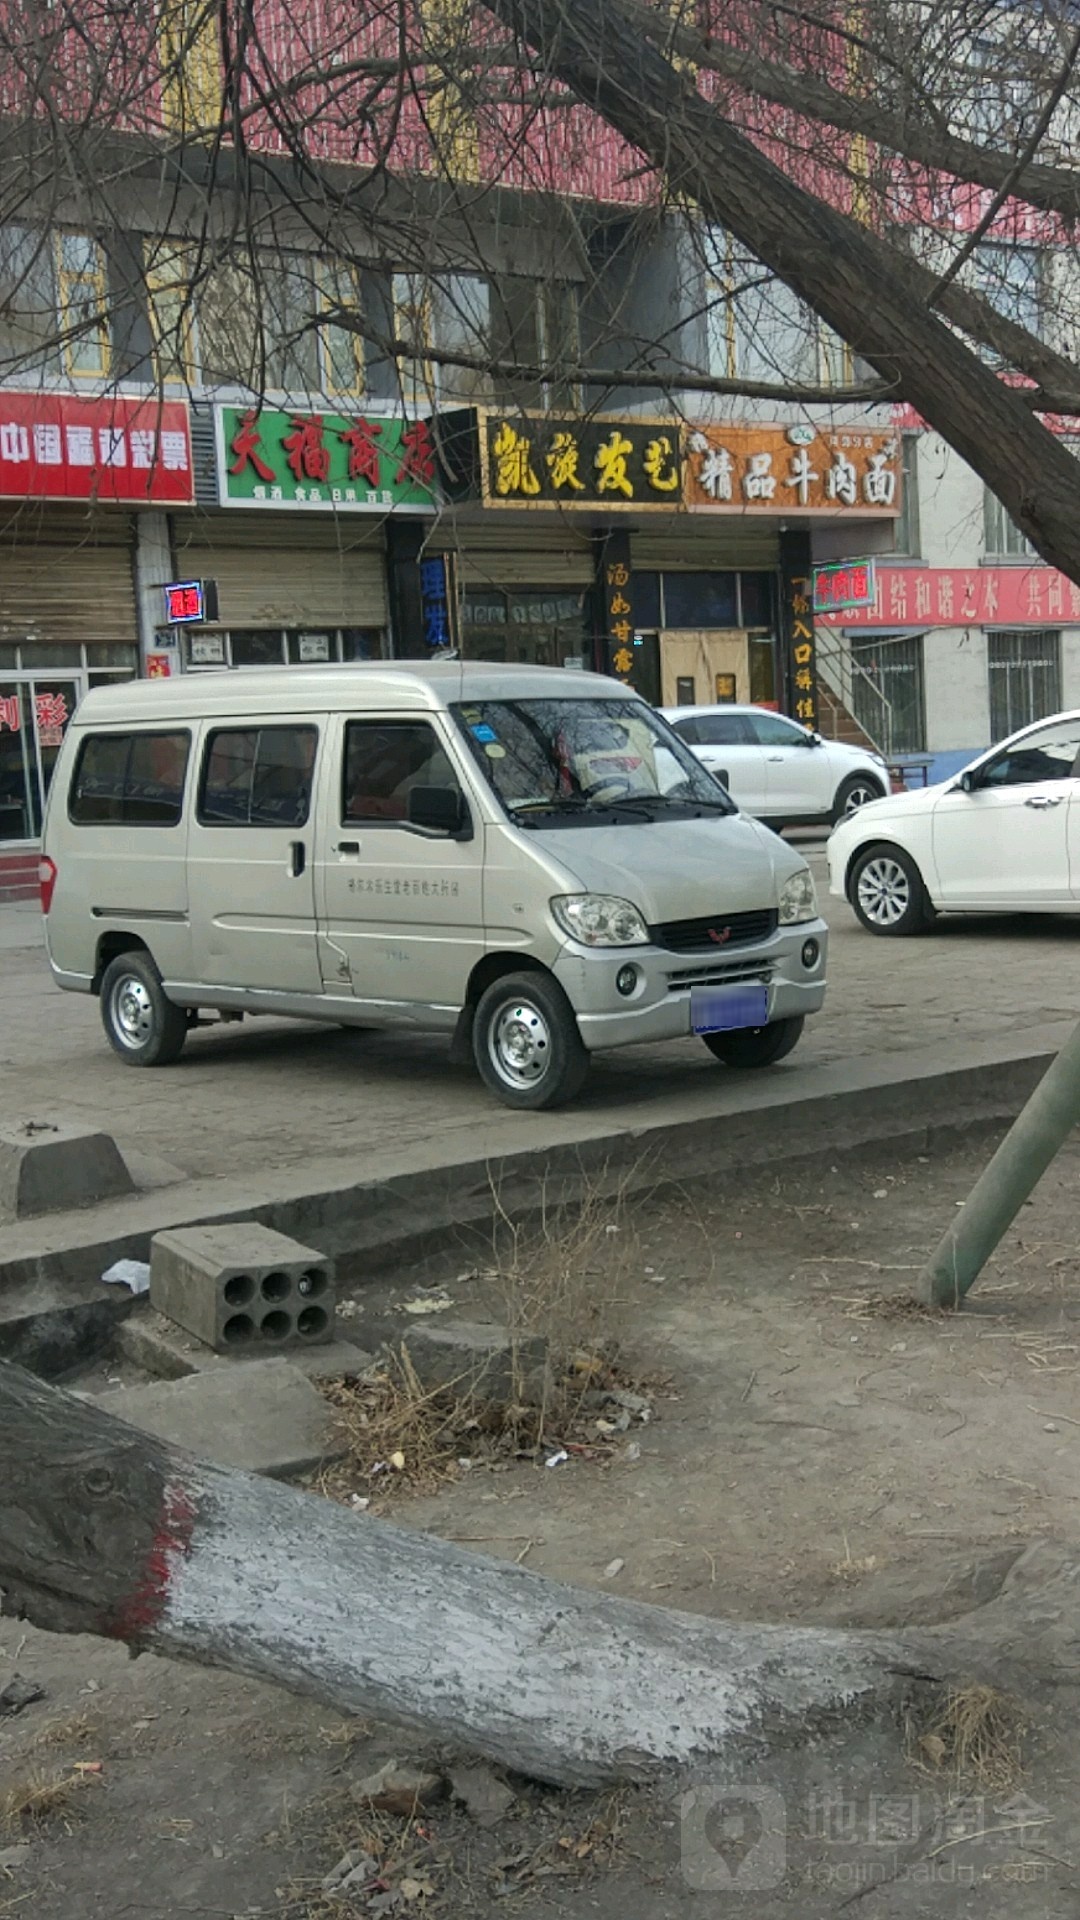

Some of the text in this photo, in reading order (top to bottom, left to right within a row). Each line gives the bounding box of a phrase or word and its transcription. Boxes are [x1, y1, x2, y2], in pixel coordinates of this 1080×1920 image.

[295, 486, 321, 502] 食品
[697, 448, 895, 505] 精品牛肉面
[816, 566, 868, 604] 牛肉面
[829, 573, 998, 620] 团结和谐之本
[607, 563, 634, 690] 汤如甘露
